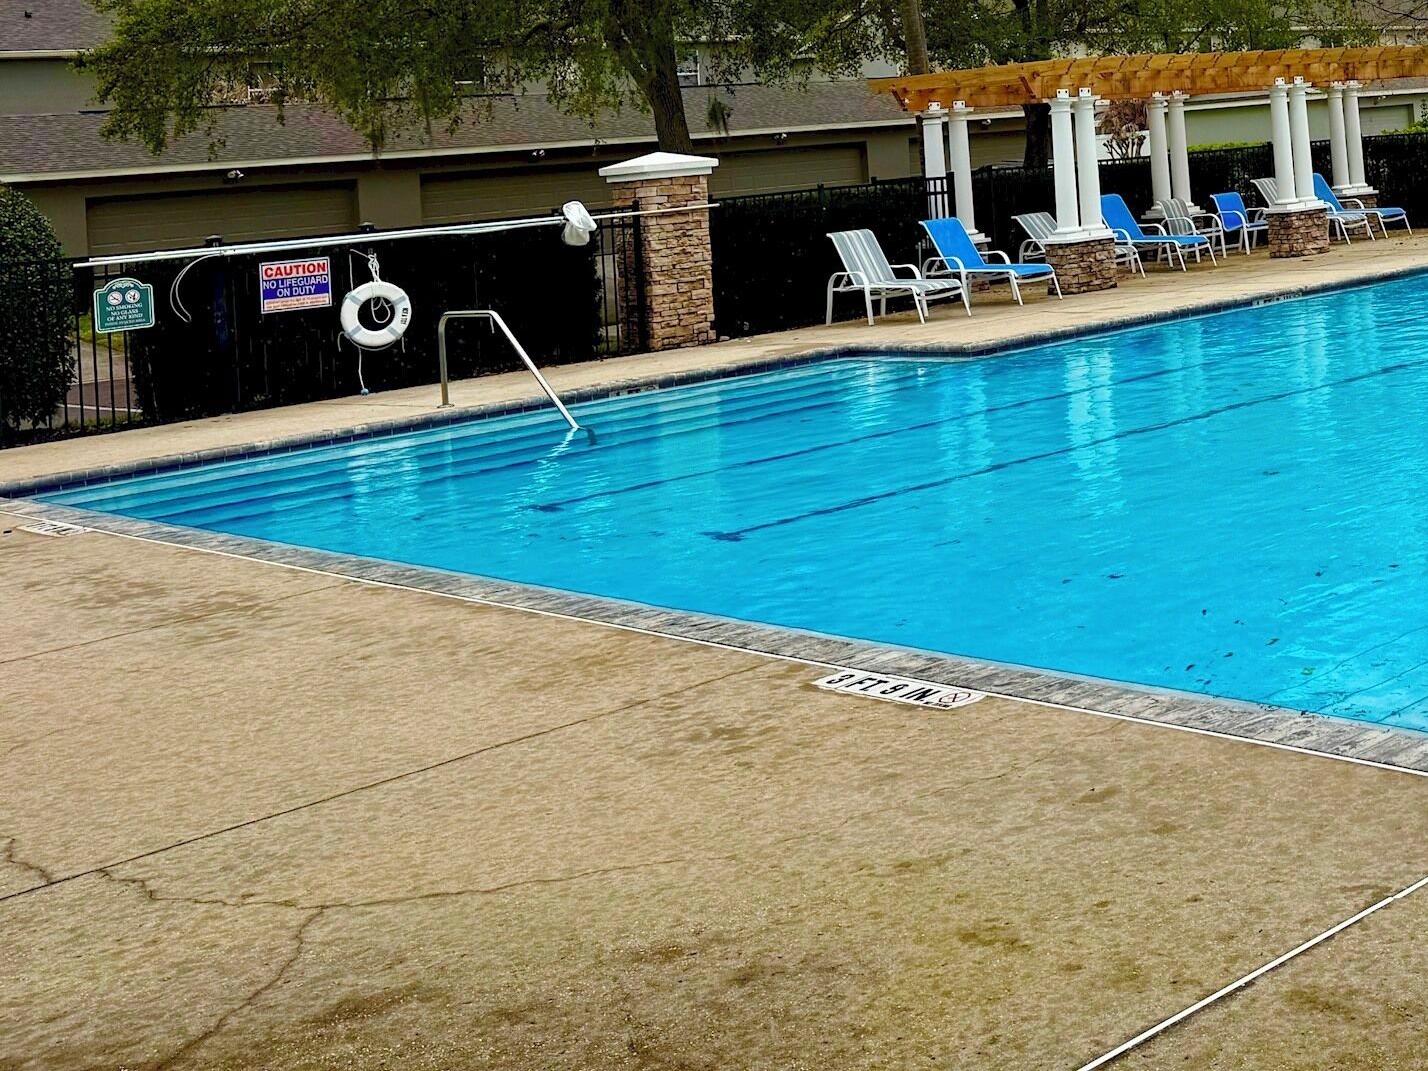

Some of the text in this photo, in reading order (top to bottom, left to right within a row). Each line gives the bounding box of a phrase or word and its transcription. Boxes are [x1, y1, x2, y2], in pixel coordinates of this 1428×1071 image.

[264, 262, 326, 278] CAUTION
[263, 275, 328, 289] NO LIFEGUARD
[276, 285, 316, 298] ON DUTY
[826, 674, 855, 684] 3
[880, 684, 909, 694] 9
